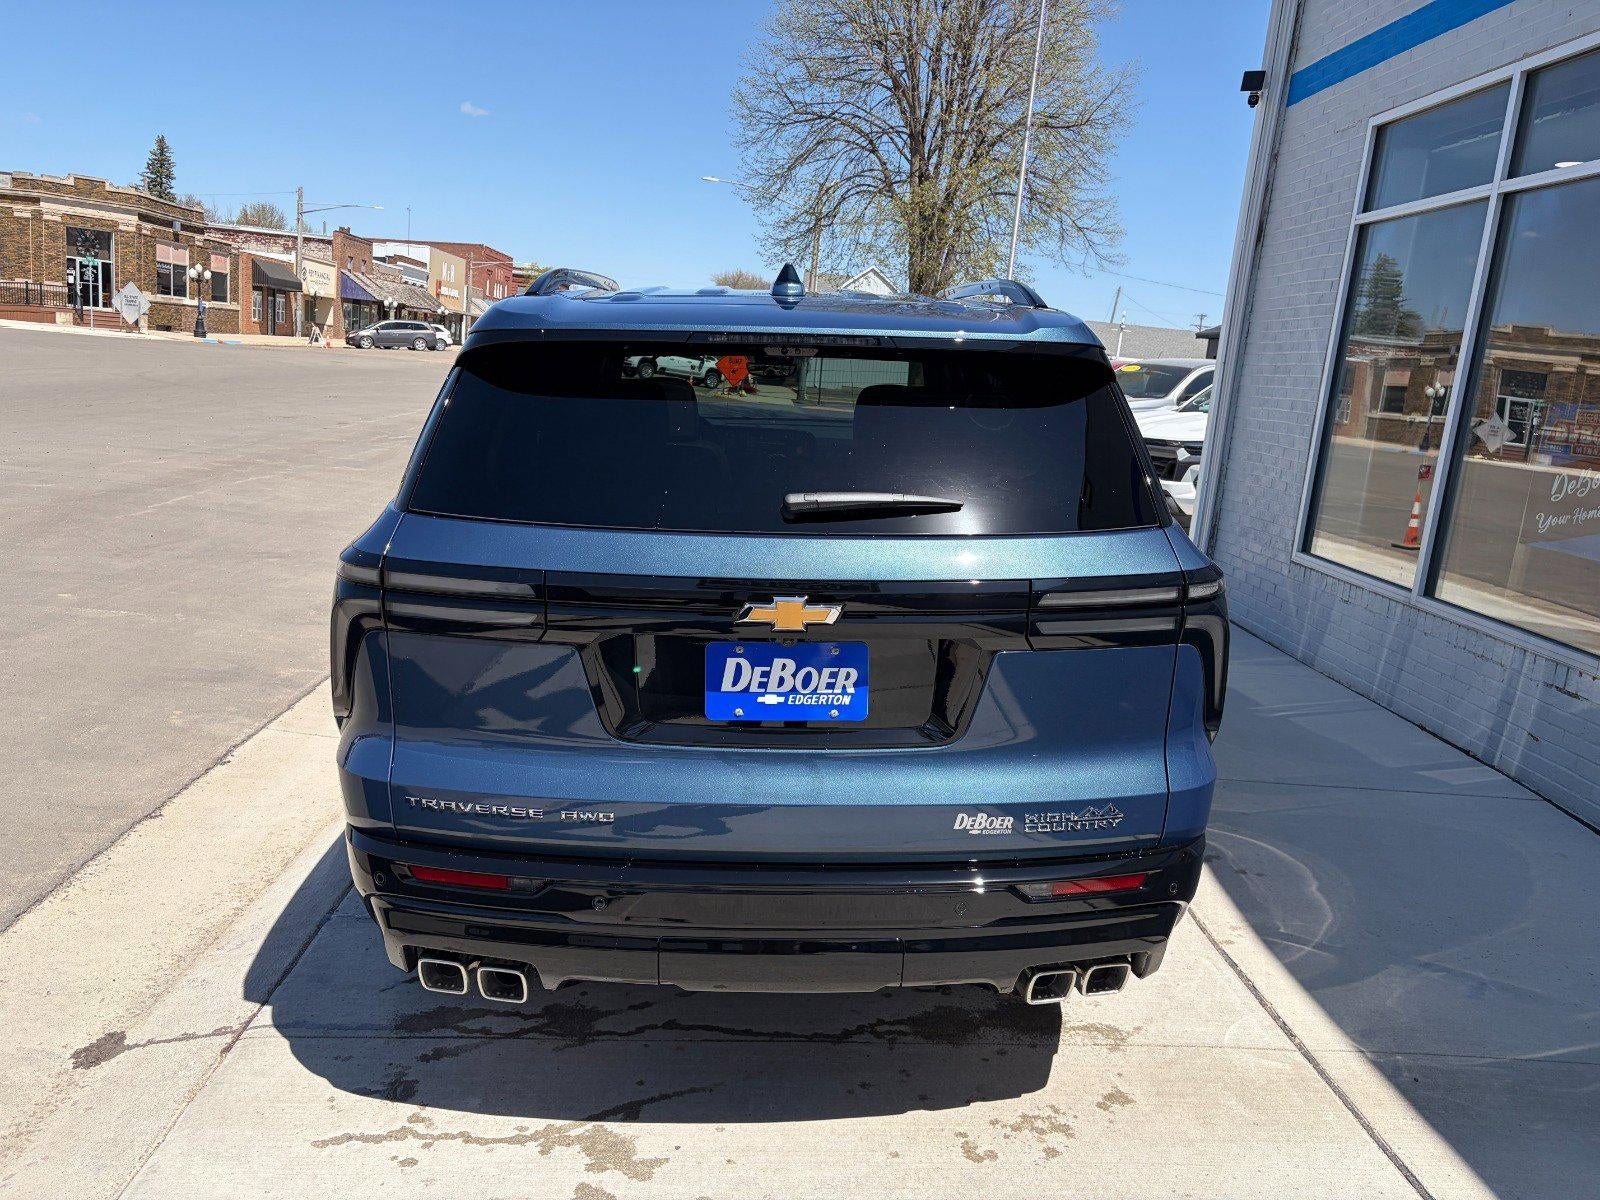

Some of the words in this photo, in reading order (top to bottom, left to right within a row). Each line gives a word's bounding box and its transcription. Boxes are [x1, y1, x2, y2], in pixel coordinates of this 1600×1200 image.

[1536, 512, 1571, 533] Your
[787, 694, 851, 705] EDGERTON
[405, 796, 544, 819] TRAVERSE
[560, 810, 615, 822] AWD
[1024, 812, 1078, 823] HIGH
[1024, 818, 1123, 833] COUNTRY
